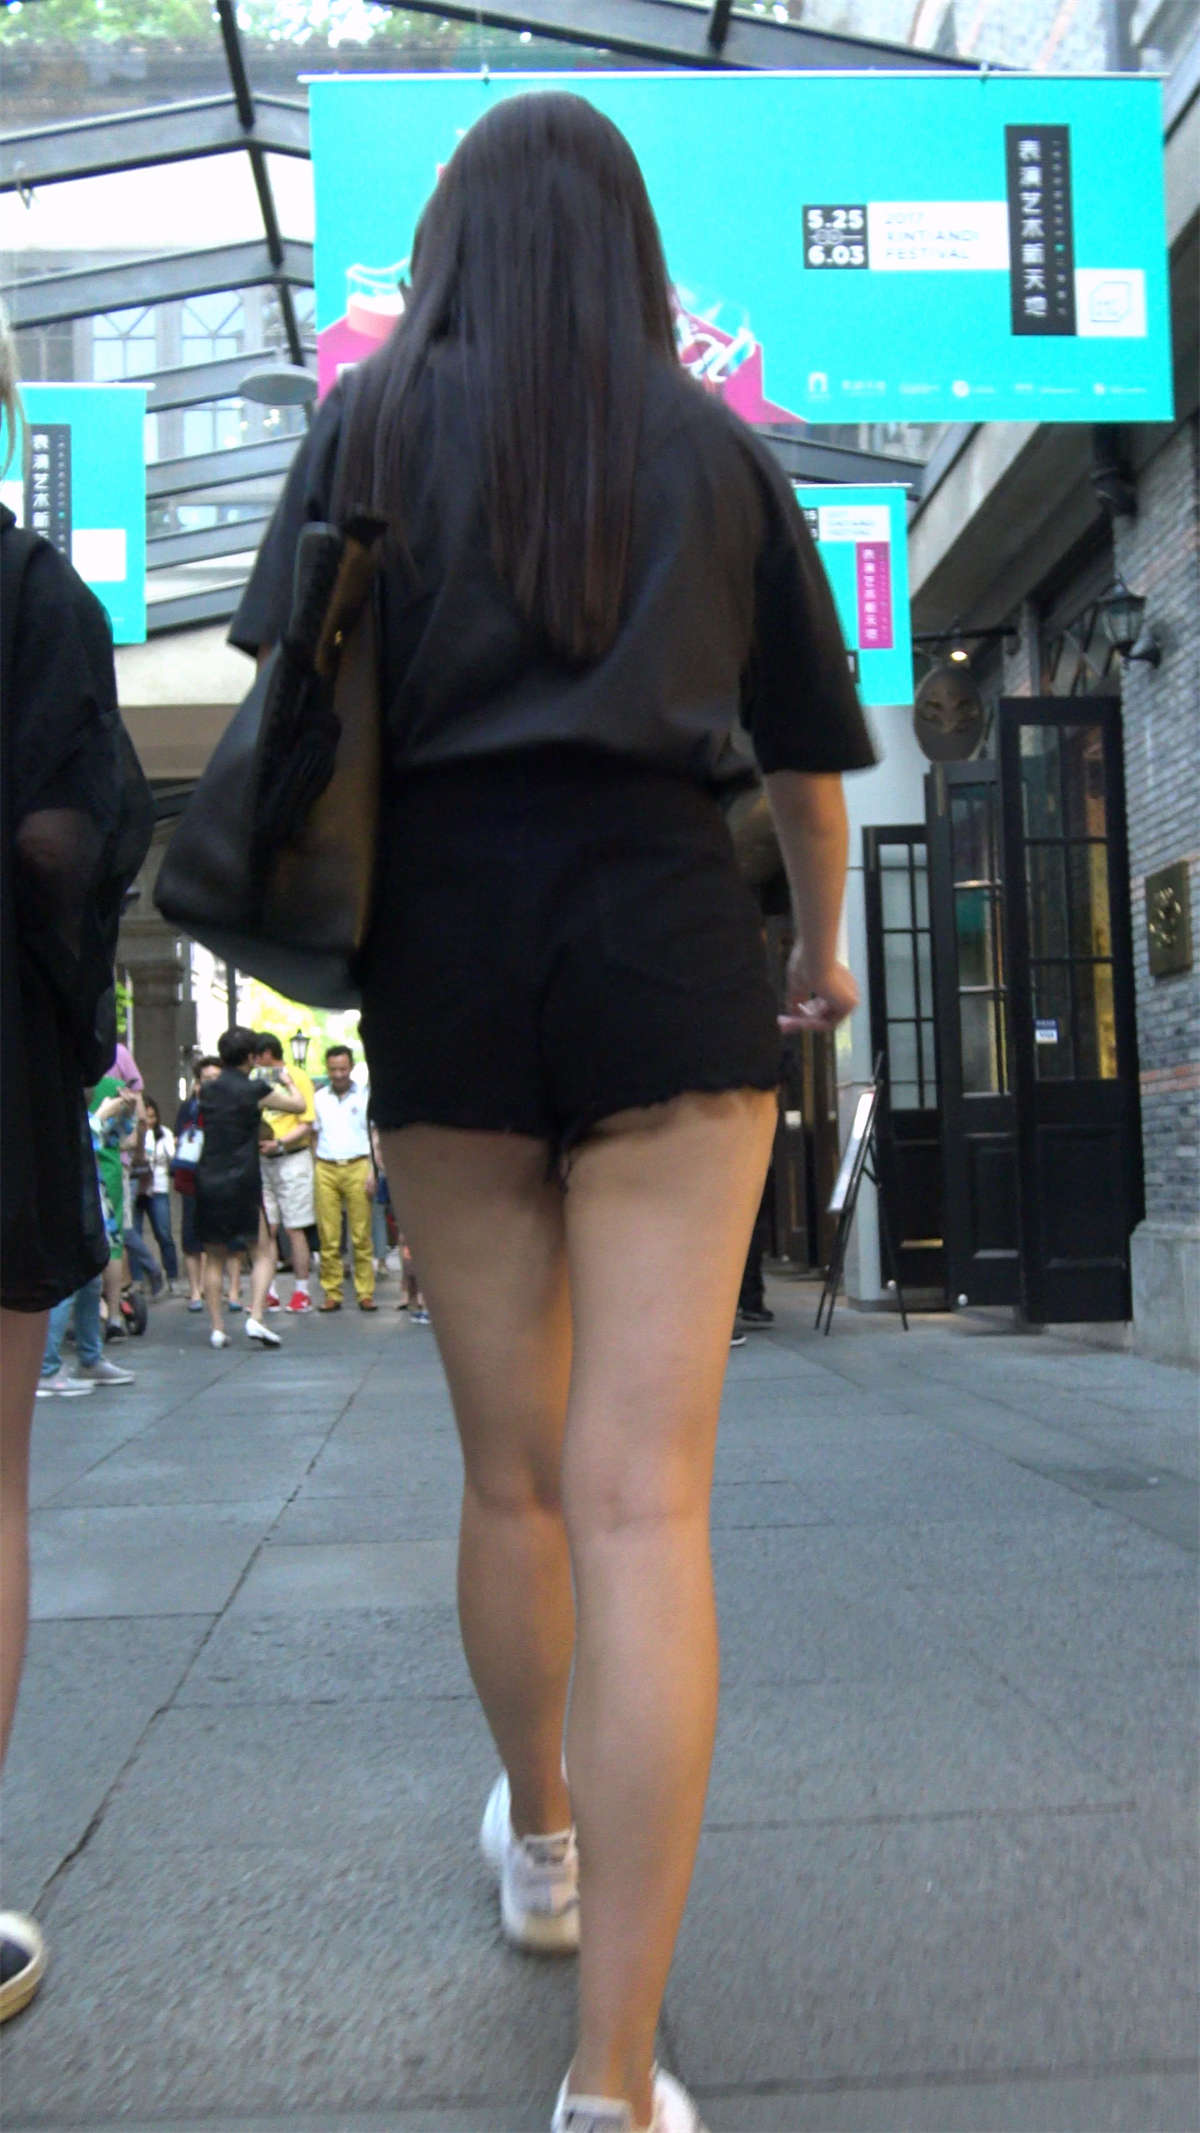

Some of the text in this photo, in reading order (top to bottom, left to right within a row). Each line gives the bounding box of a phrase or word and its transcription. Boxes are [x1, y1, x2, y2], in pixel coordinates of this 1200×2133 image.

[807, 209, 864, 229] 5.25
[1018, 139, 1047, 318] 表演艺术新天地
[807, 244, 864, 265] 6.03
